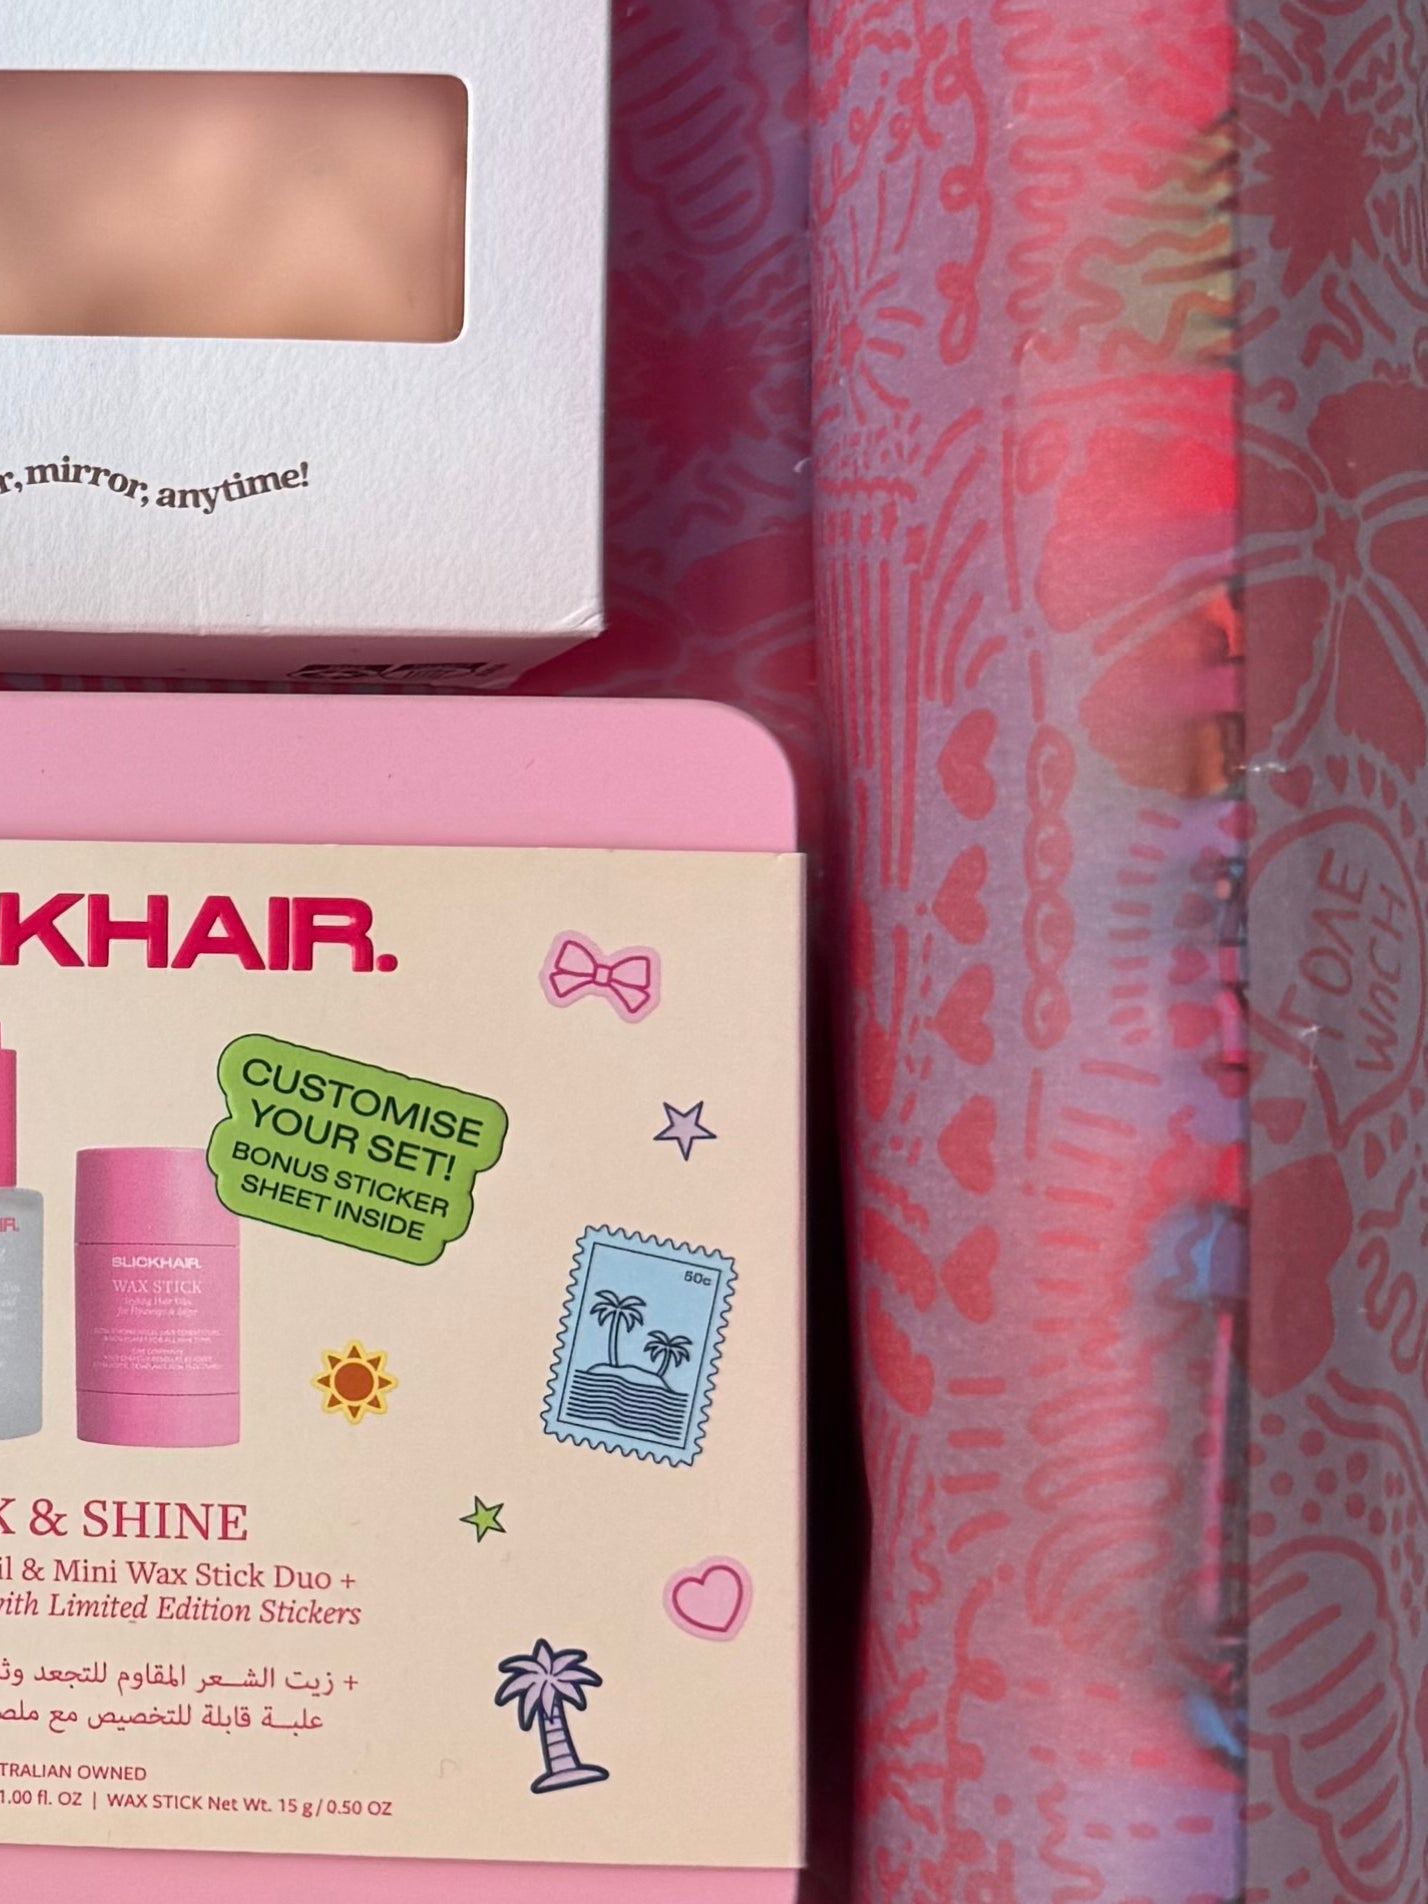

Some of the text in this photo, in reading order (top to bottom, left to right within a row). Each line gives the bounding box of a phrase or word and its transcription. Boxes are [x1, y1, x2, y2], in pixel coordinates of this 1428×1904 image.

[24, 455, 150, 507] mirror,
[156, 461, 310, 515] anytime!
[242, 1058, 484, 1148] CUSTOMISE
[251, 1099, 457, 1182] YOUR SET!
[232, 1141, 451, 1219] BONUS STICKER
[241, 1174, 426, 1241] SHEET INSIDE
[112, 1279, 204, 1295] WAX STICK
[29, 1497, 69, 1537] &
[81, 1499, 250, 1542] SHINE
[21, 1557, 46, 1583] &
[53, 1557, 118, 1584] Mini
[125, 1560, 188, 1586] Wax
[195, 1561, 265, 1588] Stick
[273, 1564, 333, 1591] Duo
[48, 1593, 149, 1621] Limited
[156, 1595, 252, 1623] Edition
[259, 1598, 363, 1626] Stickers
[33, 1661, 107, 1689] للتجعد
[117, 1664, 186, 1695] المقاوم
[285, 1672, 335, 1696] زيت
[48, 1709, 79, 1734] مع
[87, 1703, 192, 1732] للتخصيص
[201, 1706, 251, 1735] قابلة
[77, 1765, 147, 1781] OWNED
[0, 1790, 33, 1805] 1.00
[37, 1790, 54, 1806] fl.
[58, 1792, 83, 1806] OZ
[107, 1794, 148, 1809] WAX
[152, 1794, 203, 1811] STICK
[208, 1796, 238, 1812] Net
[243, 1797, 272, 1813] Wt.
[279, 1798, 297, 1813] 15
[302, 1802, 313, 1818] g
[326, 1800, 363, 1816] 0.50
[367, 1801, 393, 1816] OZ
